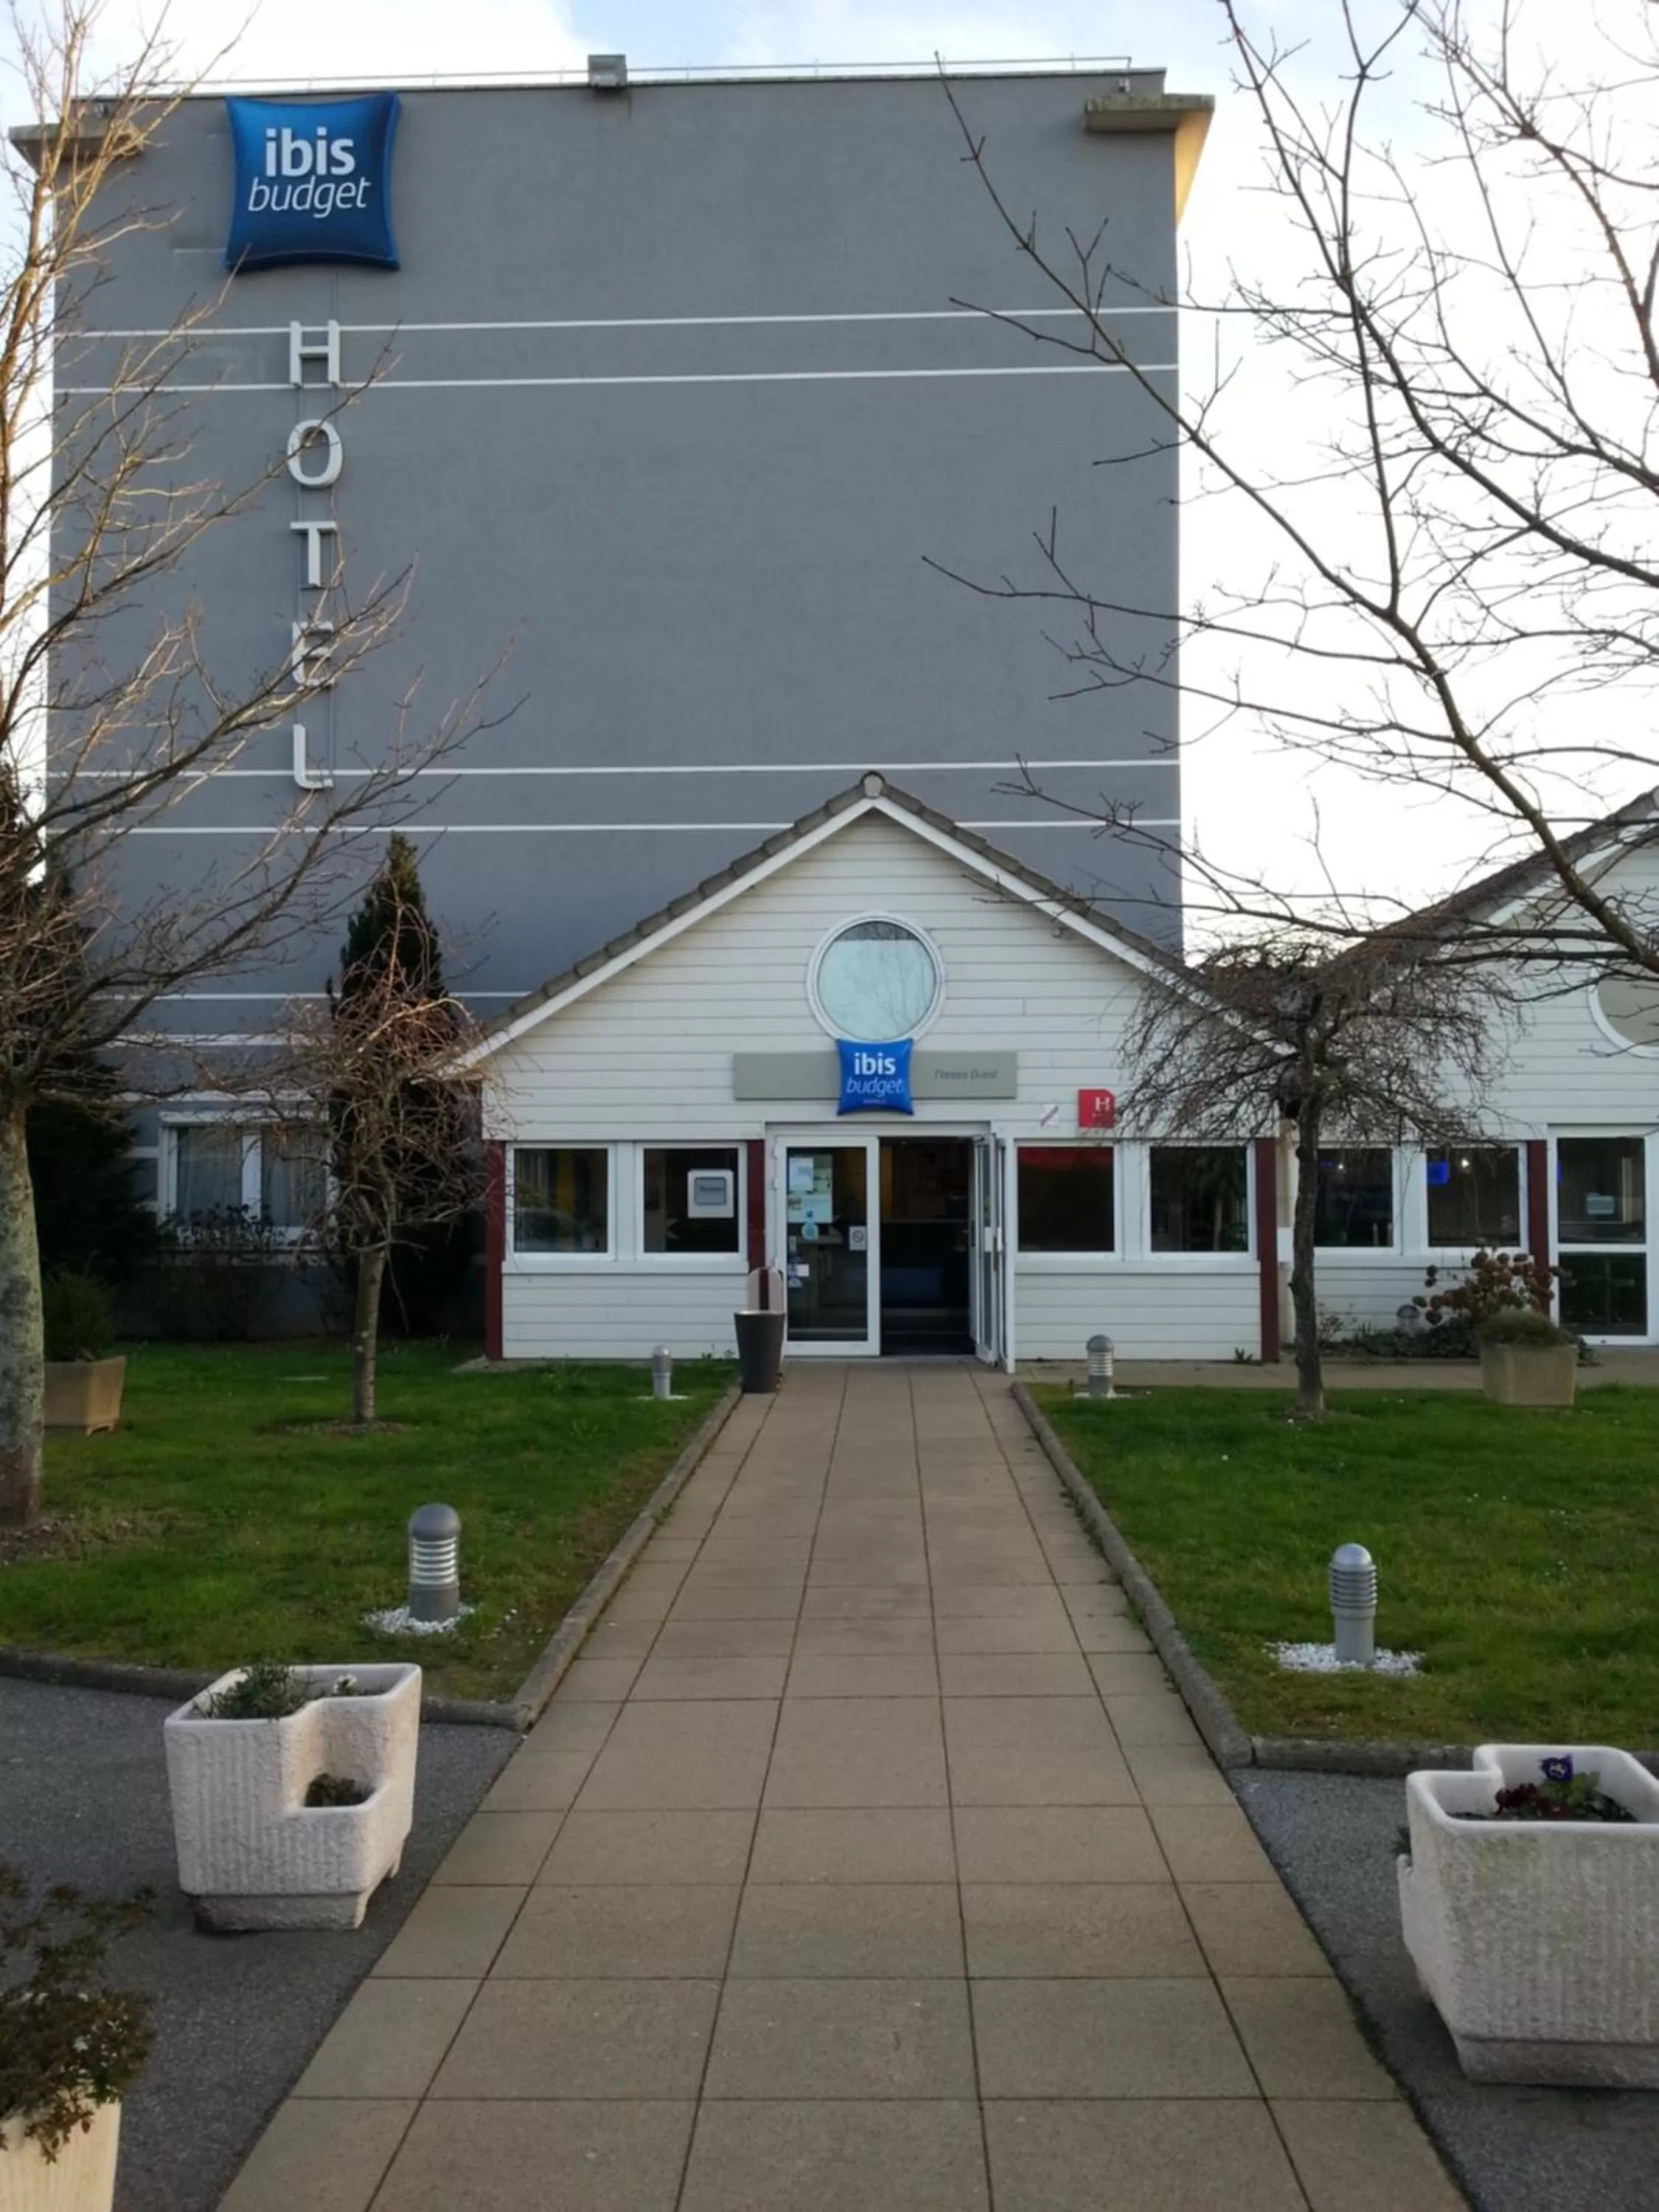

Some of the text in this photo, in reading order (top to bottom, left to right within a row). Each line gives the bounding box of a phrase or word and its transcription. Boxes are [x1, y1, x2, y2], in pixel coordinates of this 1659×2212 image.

[265, 126, 355, 177] ibis
[248, 175, 372, 218] budget
[287, 320, 343, 790] HOTEL
[854, 1051, 897, 1075] ibis
[846, 1077, 904, 1098] budget
[1095, 1096, 1110, 1112] H
